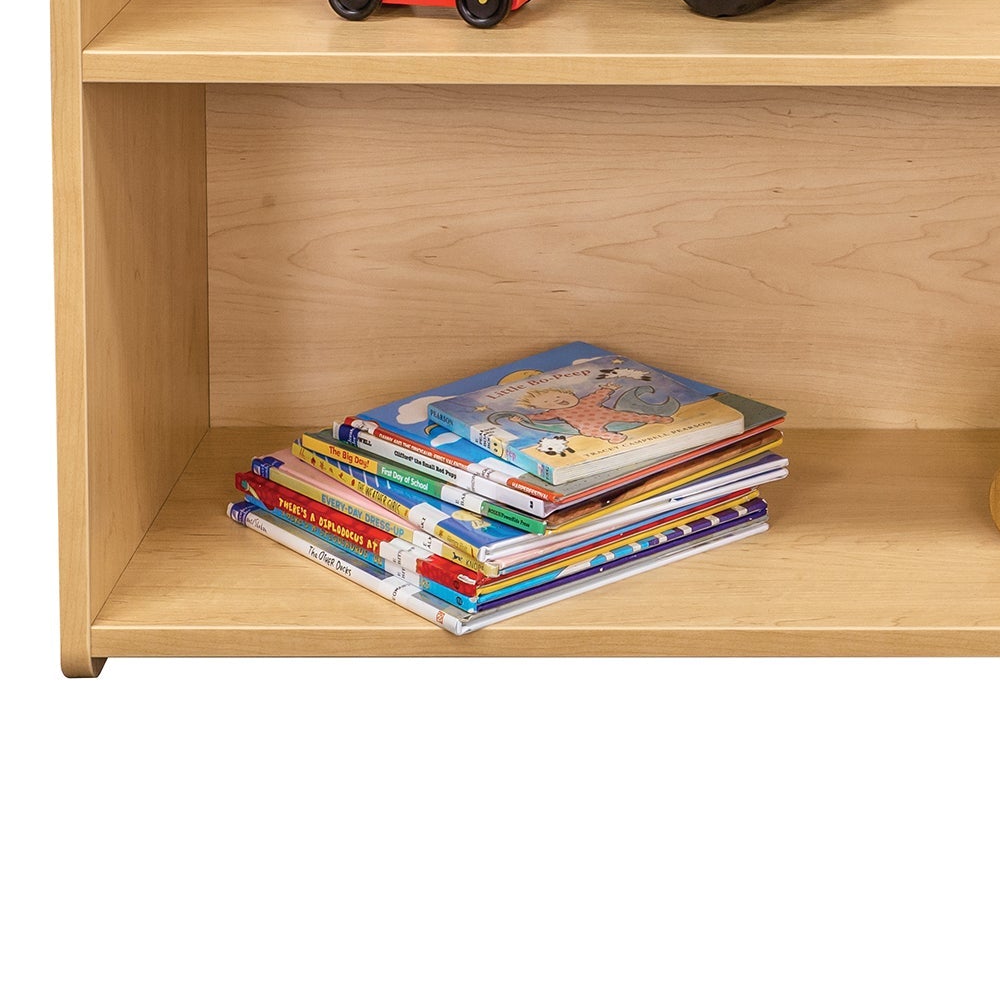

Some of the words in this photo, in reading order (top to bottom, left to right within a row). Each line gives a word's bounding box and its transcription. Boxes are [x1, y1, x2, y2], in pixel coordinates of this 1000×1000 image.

[486, 384, 525, 400] Little
[527, 368, 591, 387] Bo-Peep
[430, 409, 454, 426] PEARSON
[585, 445, 619, 458] TRACEY
[621, 432, 668, 448] CAMPBELL
[670, 420, 712, 435] PEARSON
[329, 446, 340, 457] The
[341, 450, 354, 463] Big
[354, 456, 370, 469] Day!
[414, 458, 422, 466] the
[422, 460, 435, 471] Small
[435, 465, 444, 474] Red
[444, 470, 457, 479] Puppy
[381, 466, 393, 477] First
[393, 471, 405, 483] Day
[404, 475, 411, 484] of
[410, 477, 429, 491] School
[278, 497, 307, 519] THERE'S
[310, 512, 316, 522] A
[318, 516, 364, 545] DIPLODOCUS
[366, 539, 378, 554] AT
[321, 493, 363, 519] EVERY-DAY
[364, 512, 405, 538] DRESS-UP
[335, 559, 353, 577] Ducks
